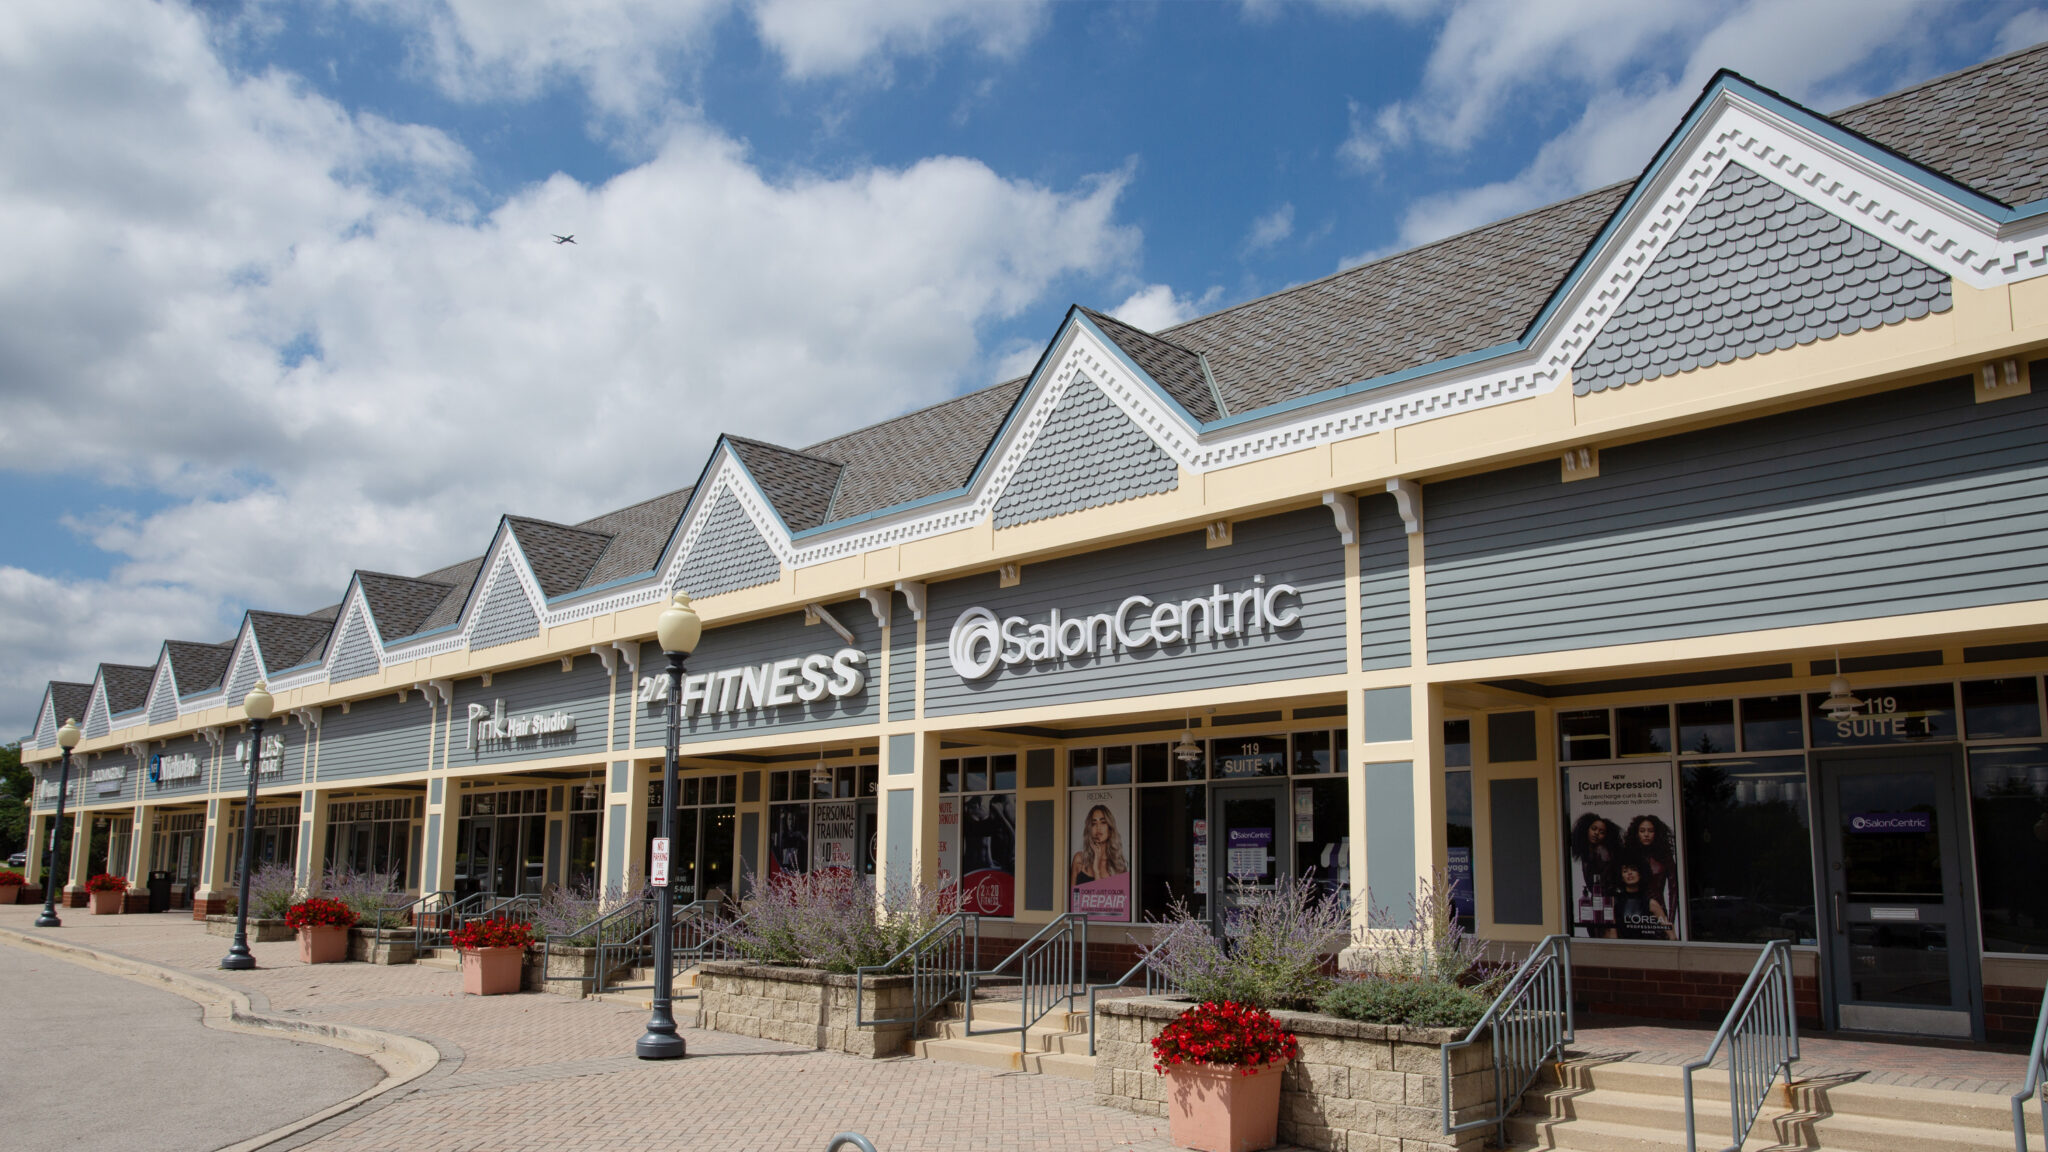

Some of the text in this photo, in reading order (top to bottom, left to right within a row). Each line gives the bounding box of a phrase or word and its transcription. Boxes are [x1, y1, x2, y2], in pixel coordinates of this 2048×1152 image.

[1000, 574, 1299, 664] SalonCentric
[638, 648, 867, 717] 2/2 FITNESS
[1864, 696, 1897, 714] 119
[466, 698, 575, 749] Pink Hair Studio
[1837, 716, 1930, 738] SUITE 1
[1241, 742, 1260, 756] 119
[1224, 757, 1275, 773] SUITE 1
[1578, 779, 1662, 792] [Curl Expression]
[1086, 791, 1113, 800] REDKEN
[816, 804, 855, 820] PERSONAL
[939, 802, 952, 813] NUTE
[1865, 818, 1926, 828] SalonCentric
[817, 822, 854, 839] TRAINING
[1237, 831, 1270, 840] SalonCentric
[657, 840, 665, 852] NO
[653, 853, 668, 861] PARKING
[1448, 855, 1468, 863] ional
[1448, 864, 1469, 872] yage
[1081, 894, 1125, 908] REPAIR
